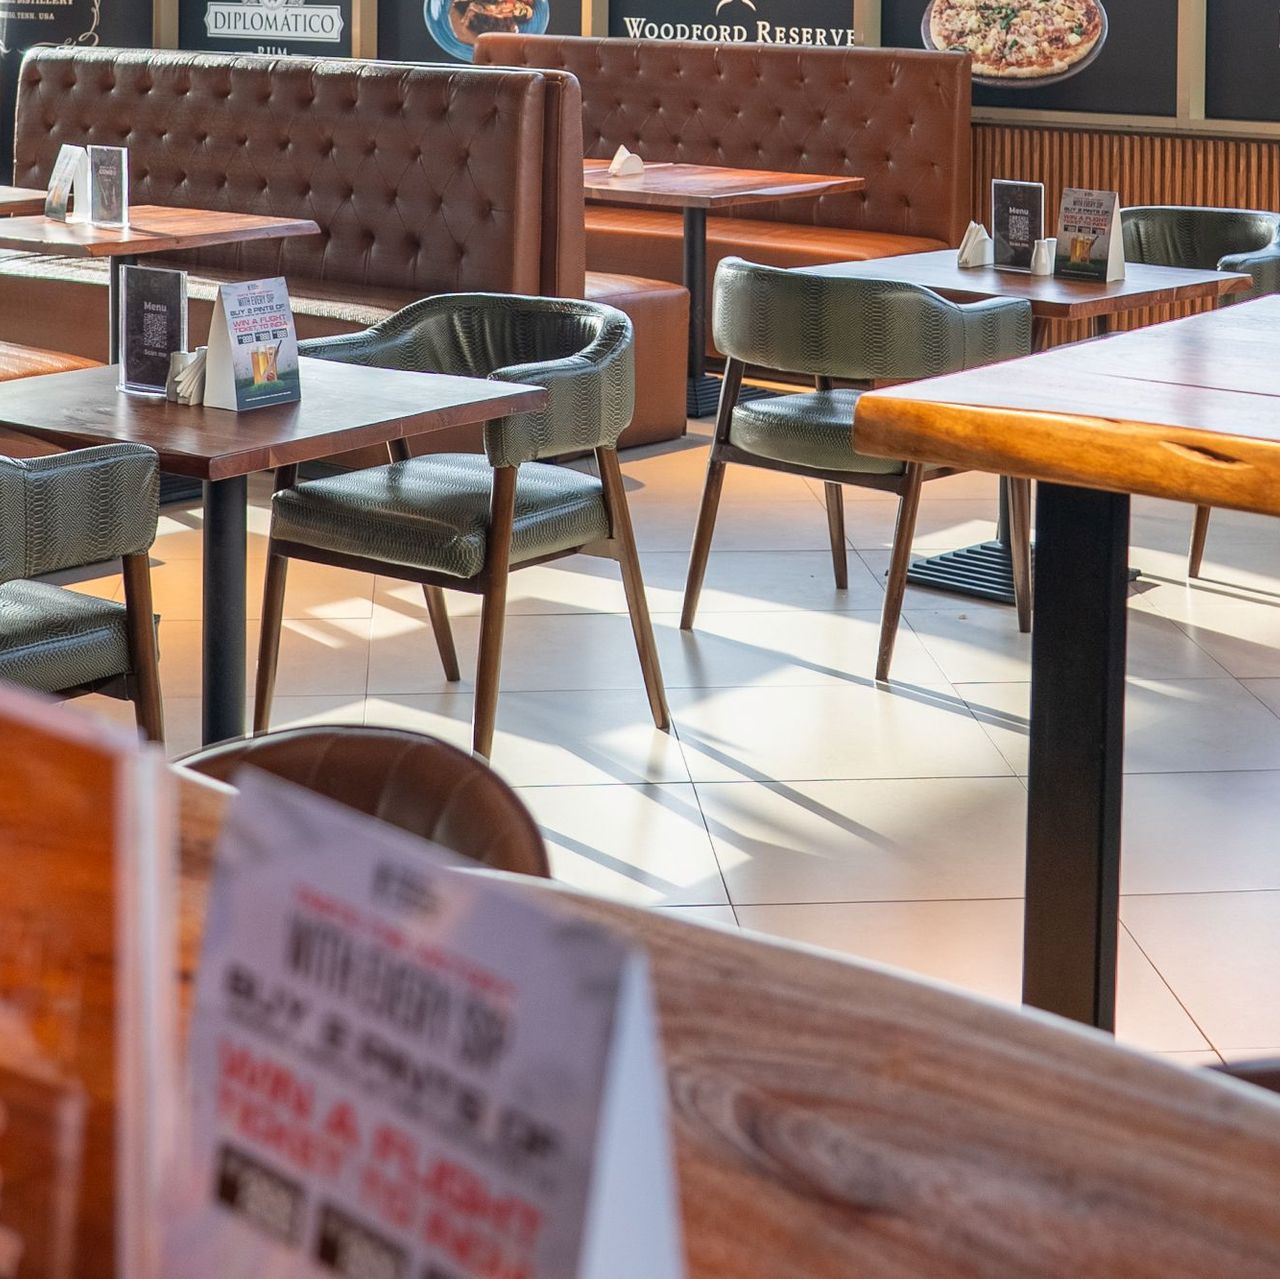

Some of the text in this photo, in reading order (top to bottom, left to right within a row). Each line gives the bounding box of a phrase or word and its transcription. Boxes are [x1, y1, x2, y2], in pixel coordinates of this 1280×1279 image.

[214, 8, 335, 33] DIPLOMÁTICO
[623, 17, 748, 42] WOODFORD
[1009, 207, 1028, 215] Menu
[238, 296, 250, 307] WITH
[251, 294, 264, 306] EVERY
[265, 293, 274, 303] SIP
[144, 301, 167, 312] Menu
[253, 306, 274, 314] PINTS
[232, 320, 251, 328] WIN
[261, 315, 286, 325] FLIGHT
[234, 324, 257, 333] TICKET
